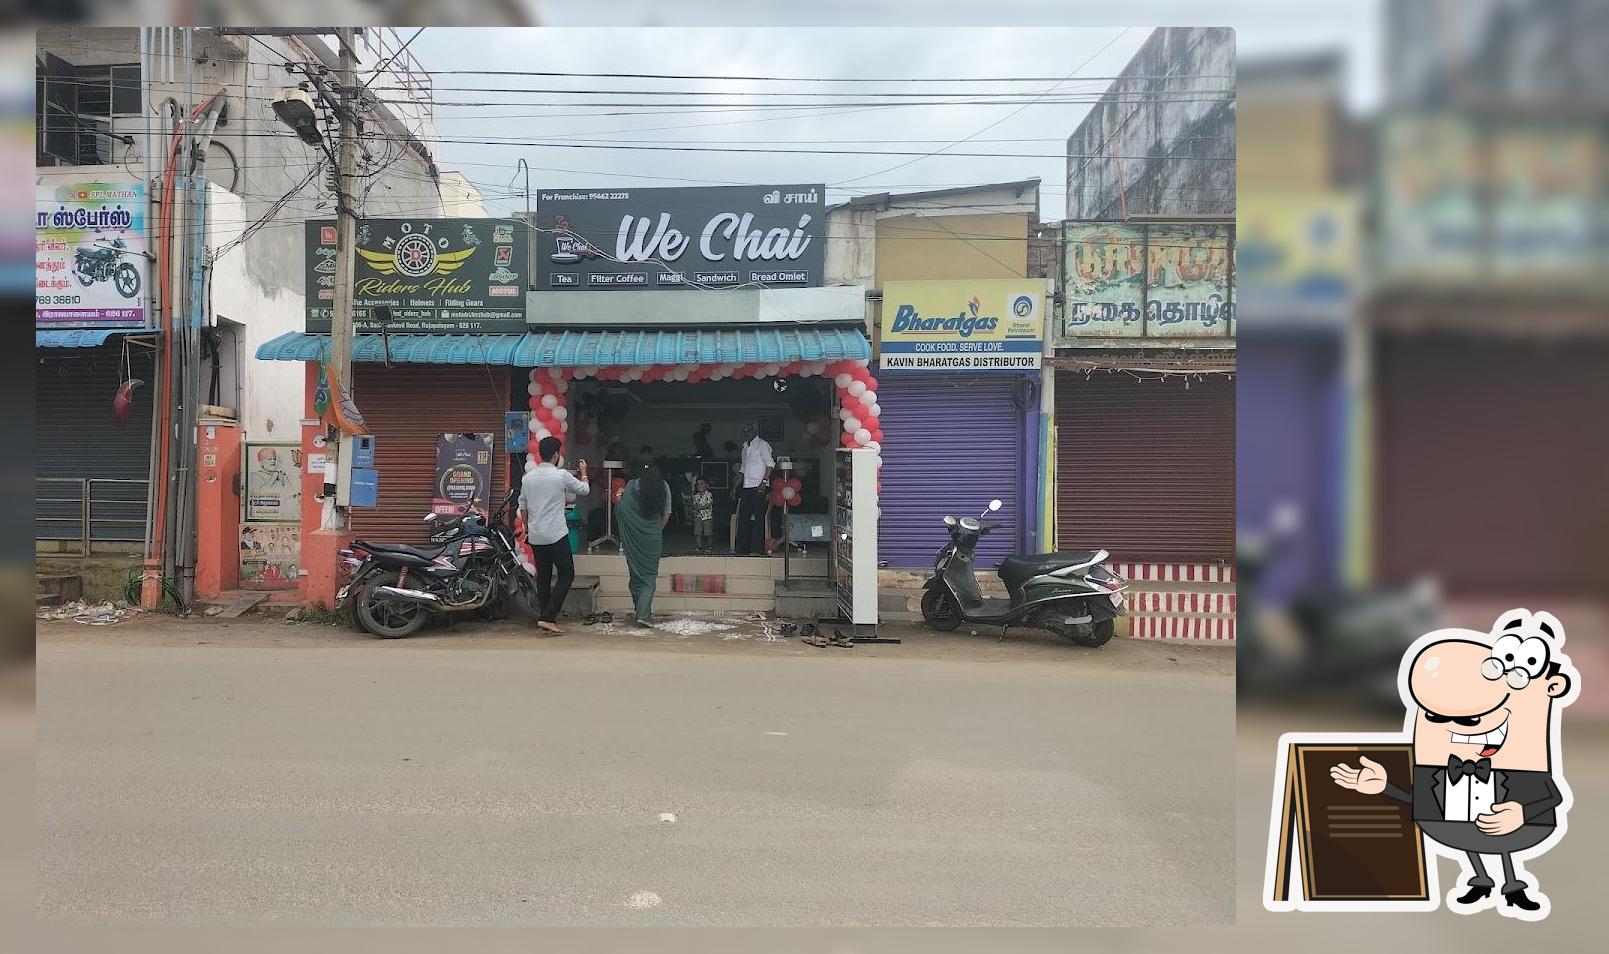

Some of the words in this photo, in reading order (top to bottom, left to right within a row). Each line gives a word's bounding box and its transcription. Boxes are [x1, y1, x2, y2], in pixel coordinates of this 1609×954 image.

[554, 192, 588, 200] Franchise:
[763, 190, 780, 204] வி
[784, 188, 818, 204] சாய்
[53, 204, 131, 227] ஸ்பேர்ஸ்
[382, 222, 449, 250] MOTO
[615, 212, 690, 262] We
[699, 212, 812, 261] Chai
[557, 275, 572, 283] Tea
[591, 275, 614, 283] Filter
[616, 274, 644, 283] Coffee
[696, 273, 737, 282] Sandwich
[751, 272, 776, 281] Bread
[778, 272, 806, 281] Omlet
[355, 277, 420, 297] Riders
[423, 277, 472, 297] Hub
[410, 299, 435, 307] Helmets
[465, 299, 483, 307] Gears
[891, 304, 998, 338] Bharatgas
[915, 343, 936, 352] COOK
[936, 343, 958, 352] FOOD.
[959, 343, 982, 352] SERVE
[983, 342, 1004, 351] LOVE.
[887, 357, 915, 367] KAVIN
[917, 357, 971, 367] BHARATGAS
[973, 357, 1034, 367] DISTRIBUTOR
